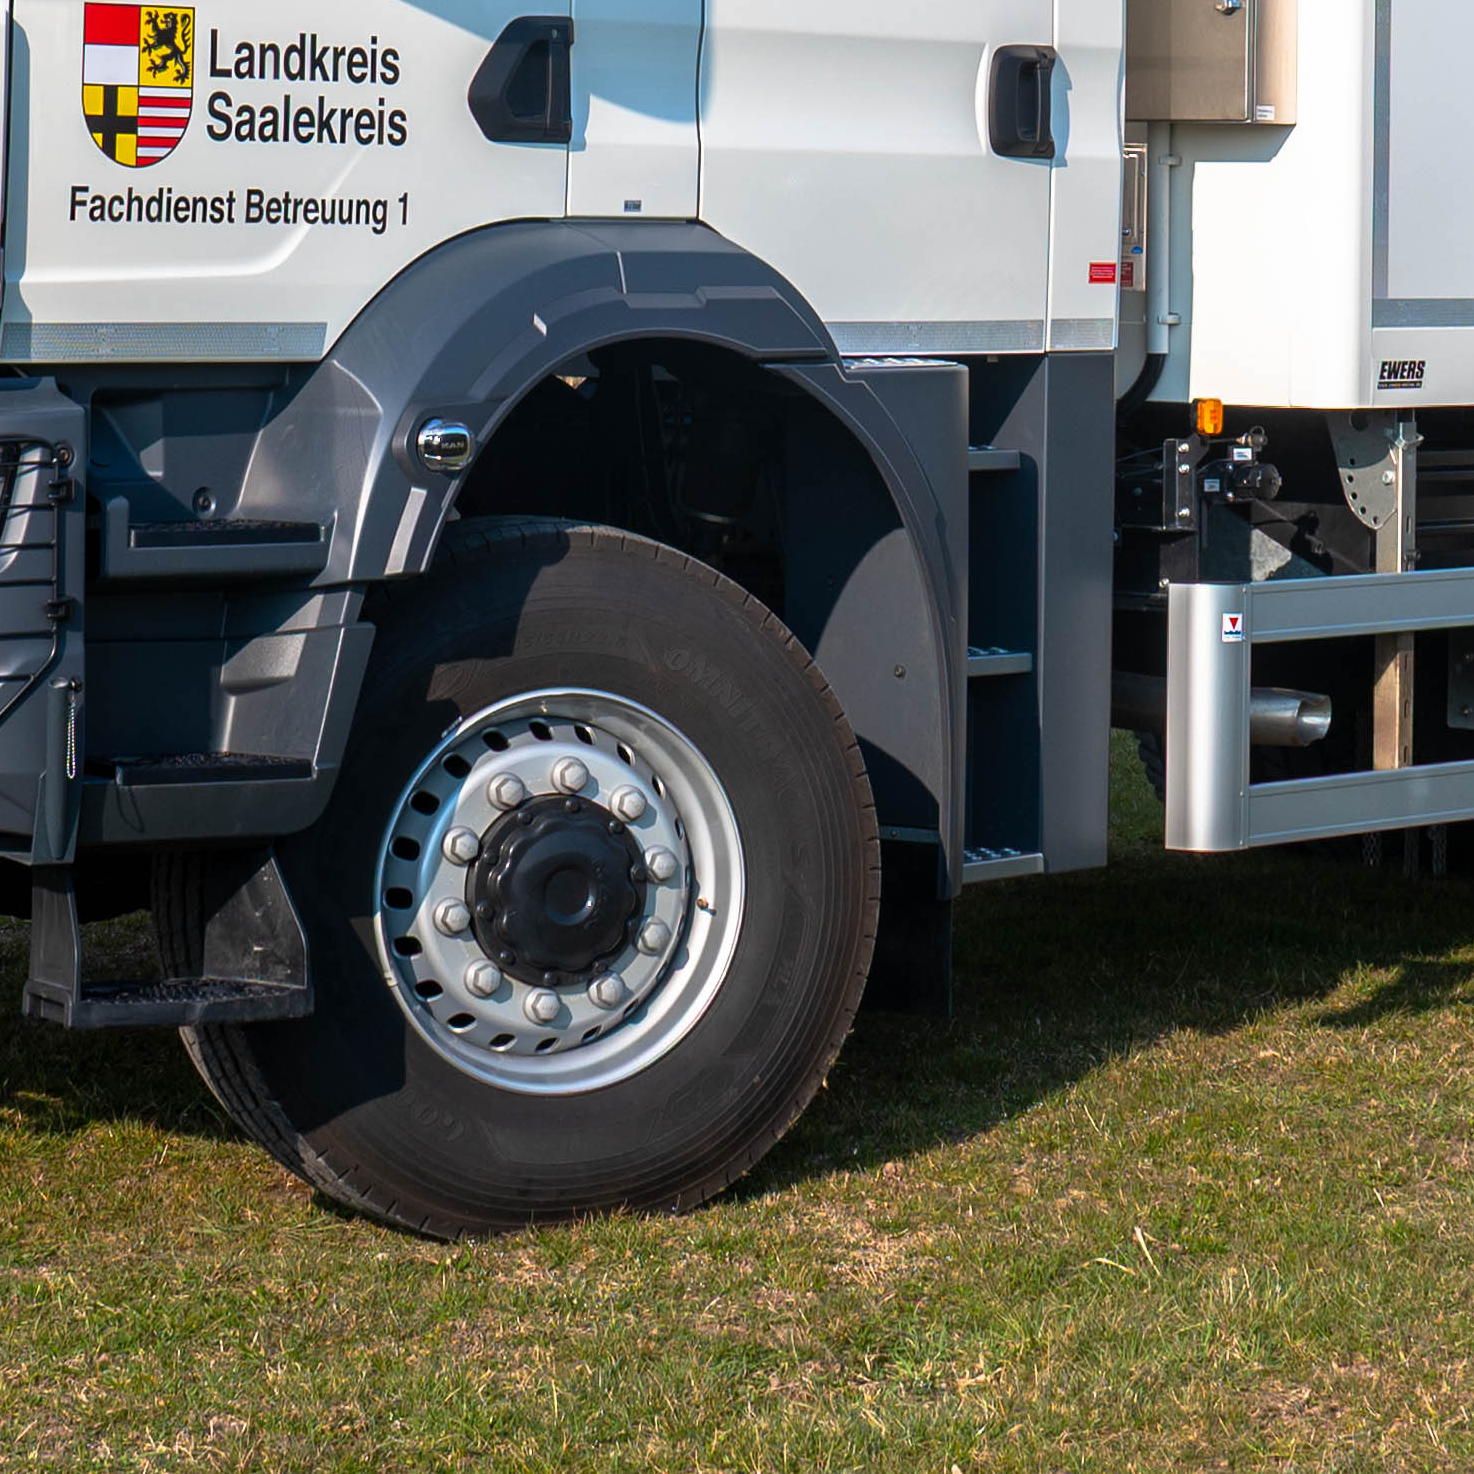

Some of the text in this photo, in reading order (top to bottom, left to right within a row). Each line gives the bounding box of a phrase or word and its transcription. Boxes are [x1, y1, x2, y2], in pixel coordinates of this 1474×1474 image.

[209, 28, 400, 85] Landkreis
[206, 91, 407, 147] Saalekreis
[69, 185, 408, 235] Fachdienst Betreuung 1
[1379, 360, 1426, 380] EWERS
